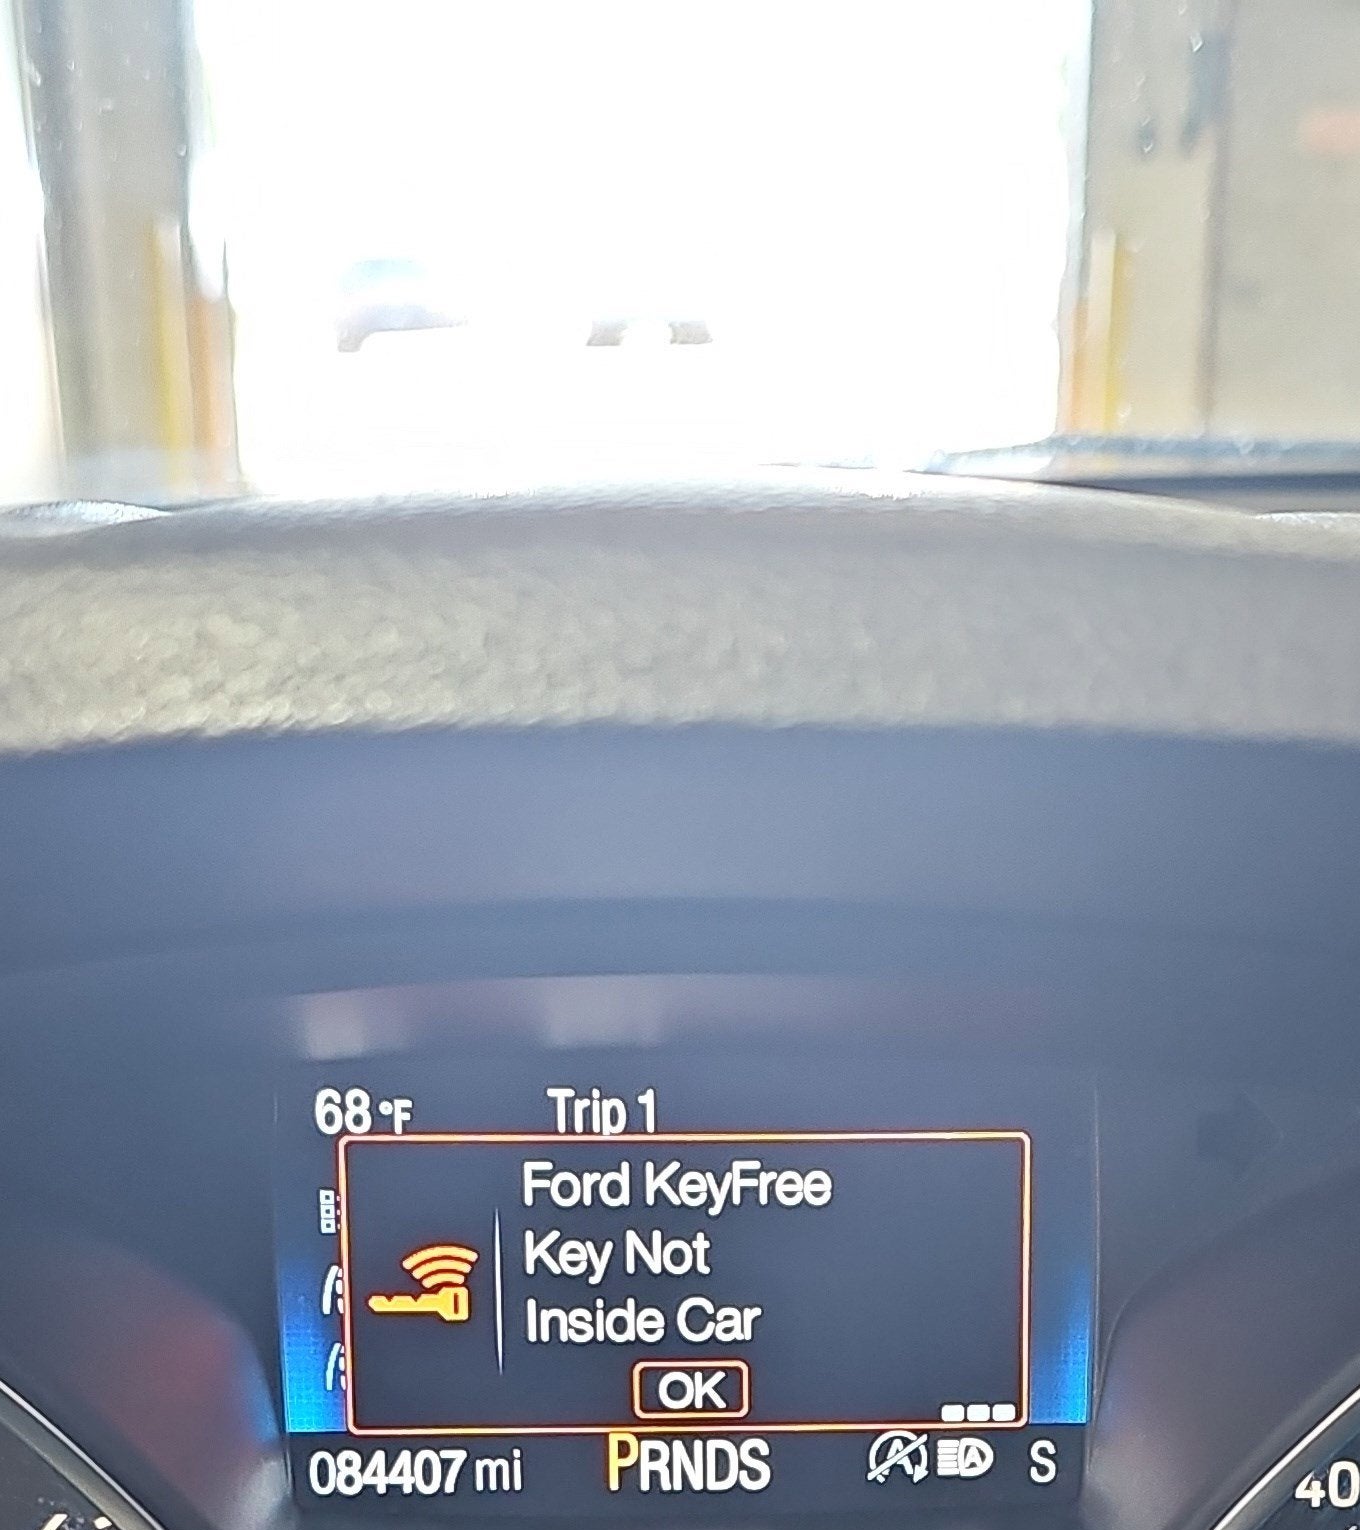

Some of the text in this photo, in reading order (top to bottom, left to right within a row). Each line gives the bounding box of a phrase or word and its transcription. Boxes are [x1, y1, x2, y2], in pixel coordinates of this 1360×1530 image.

[548, 1089, 658, 1134] Trip 1
[523, 1162, 832, 1216] Ford KeyFree
[524, 1232, 710, 1283] Key Not
[526, 1297, 761, 1344] Inside Car
[658, 1373, 725, 1409] OK
[309, 1450, 523, 1496] 084407 mi
[608, 1434, 772, 1491] PRNDS
[1030, 1444, 1056, 1483] S
[1295, 1461, 1360, 1508] 40
